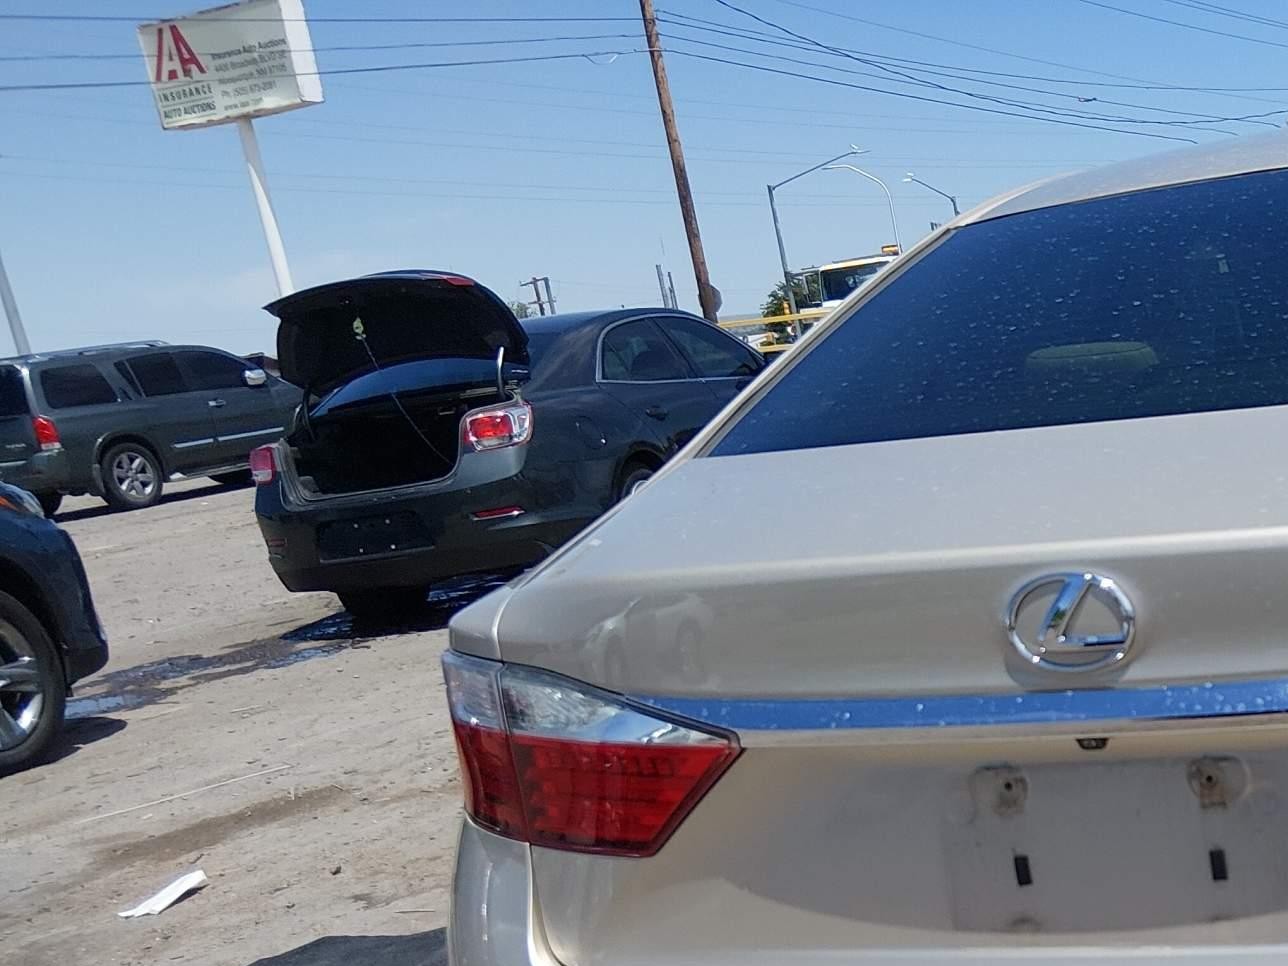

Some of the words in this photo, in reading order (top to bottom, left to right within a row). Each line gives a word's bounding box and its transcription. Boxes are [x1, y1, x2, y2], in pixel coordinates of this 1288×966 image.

[257, 38, 287, 49] Auctions
[158, 83, 213, 103] INSURANCE
[163, 106, 182, 120] AUTO
[184, 101, 217, 115] AUCTIONS
